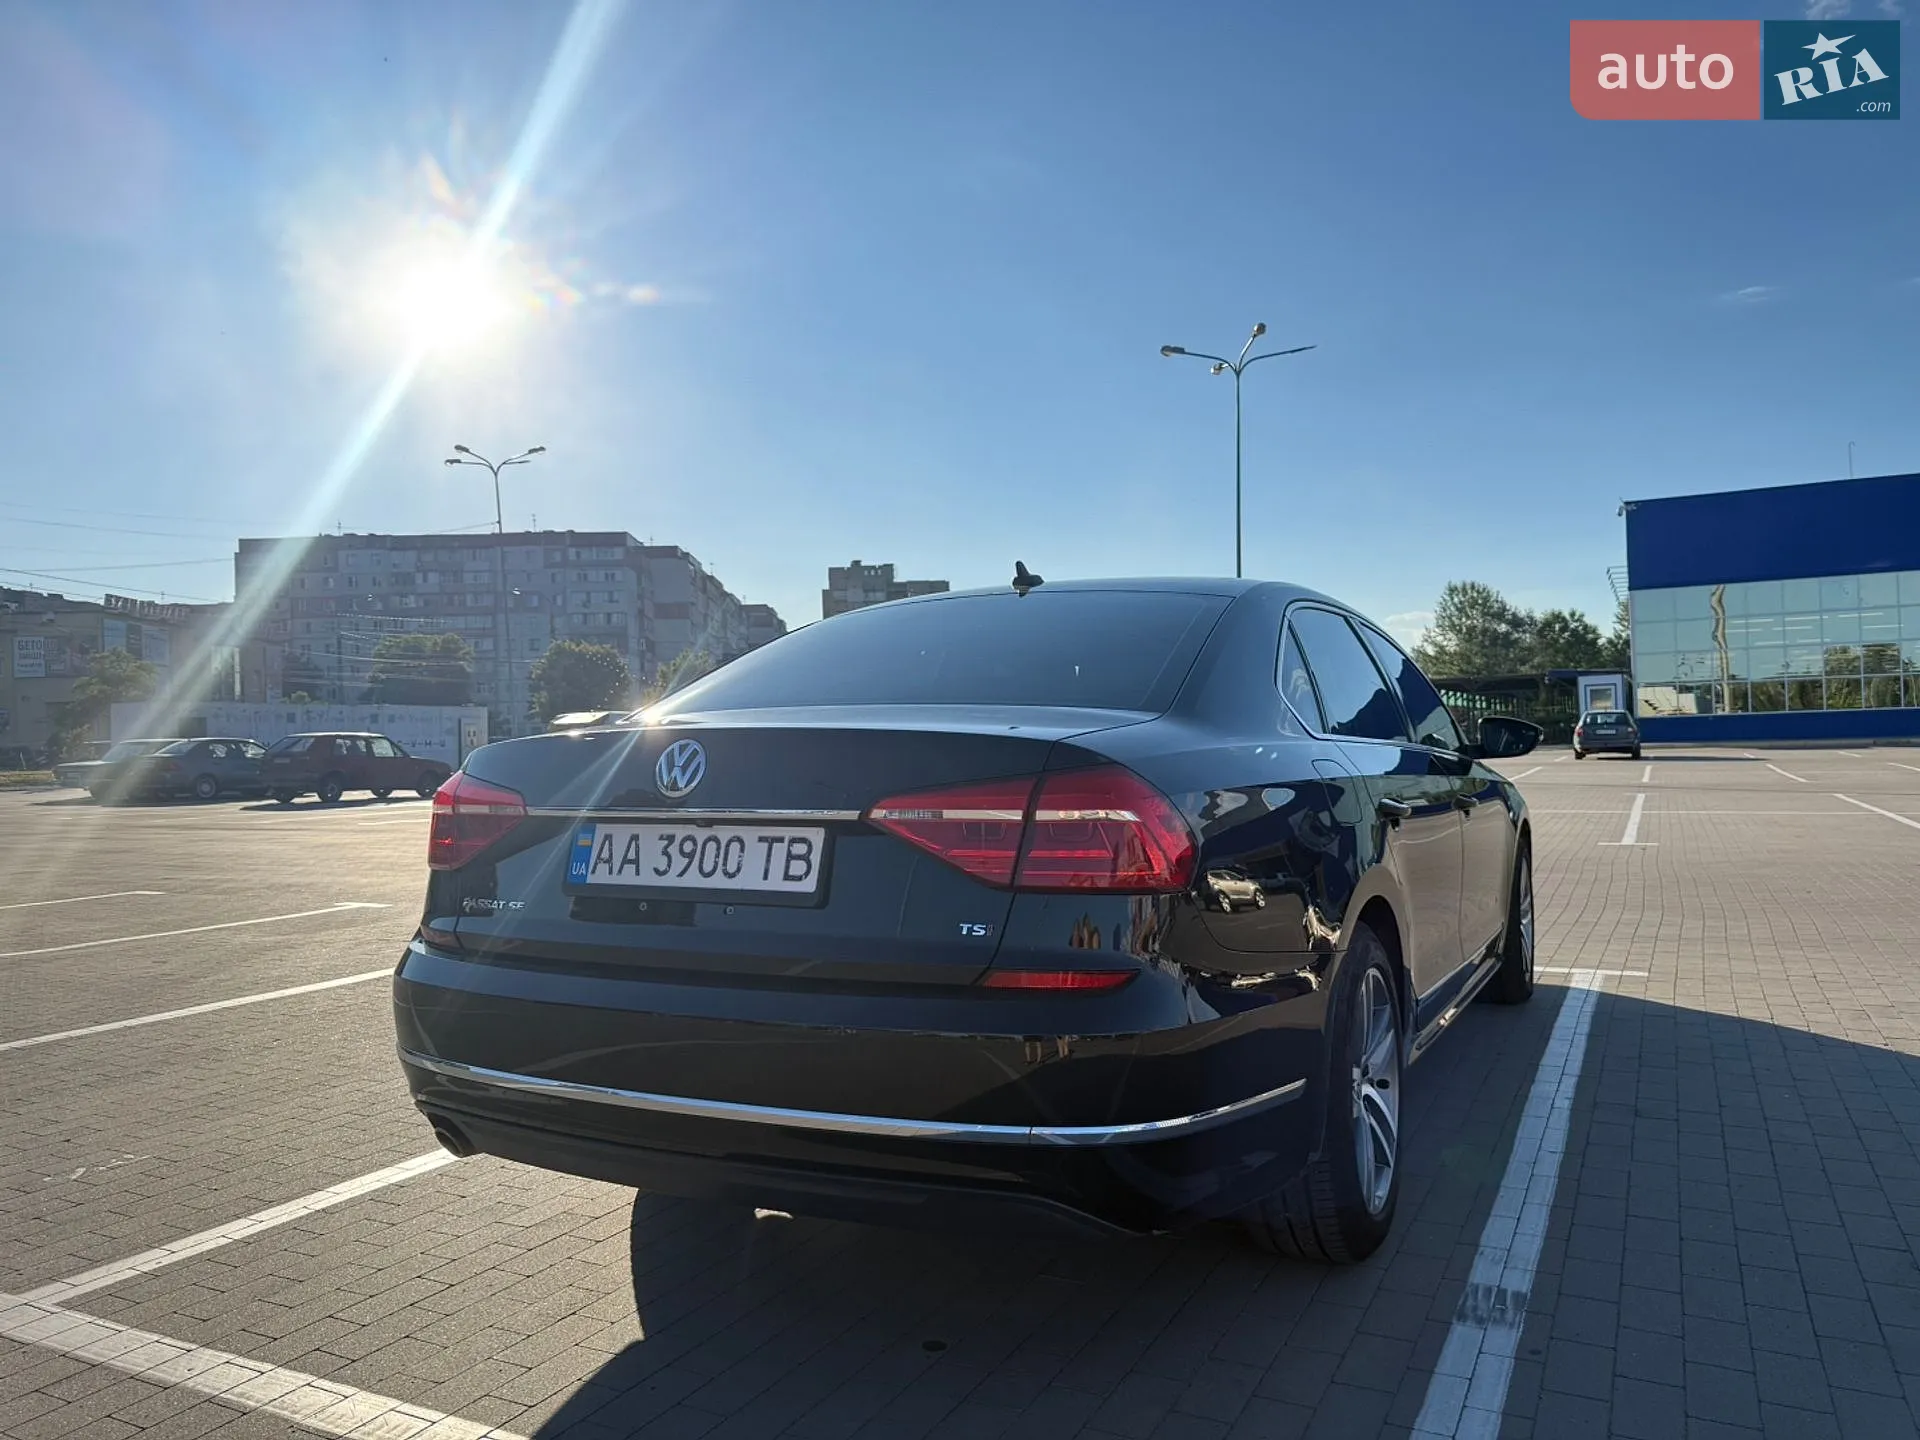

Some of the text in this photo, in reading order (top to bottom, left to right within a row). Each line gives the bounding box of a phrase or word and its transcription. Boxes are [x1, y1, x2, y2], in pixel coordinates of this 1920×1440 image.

[571, 862, 587, 876] UA
[591, 832, 815, 882] AA 3900 TB
